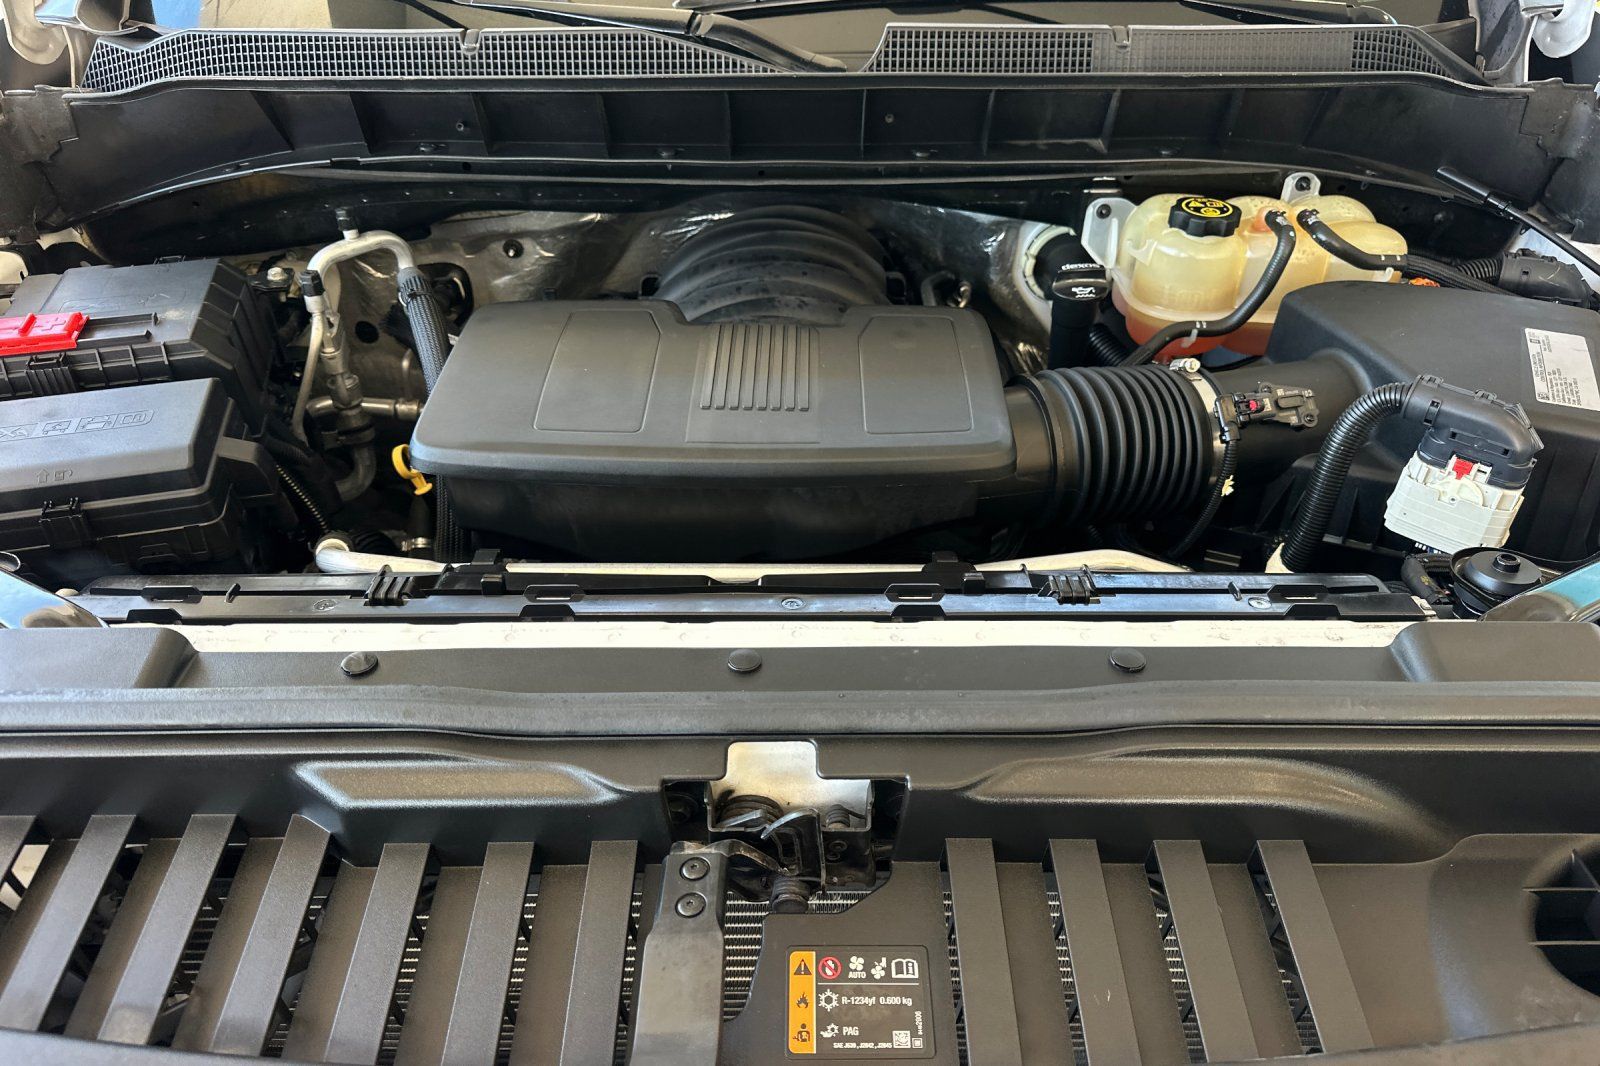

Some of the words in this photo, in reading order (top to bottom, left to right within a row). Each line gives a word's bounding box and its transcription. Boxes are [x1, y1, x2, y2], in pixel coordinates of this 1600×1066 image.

[848, 971, 867, 979] AUTO
[841, 996, 876, 1006] R-1234yf
[880, 996, 901, 1005] 0.600
[902, 996, 913, 1006] kg
[842, 1026, 860, 1036] PAG
